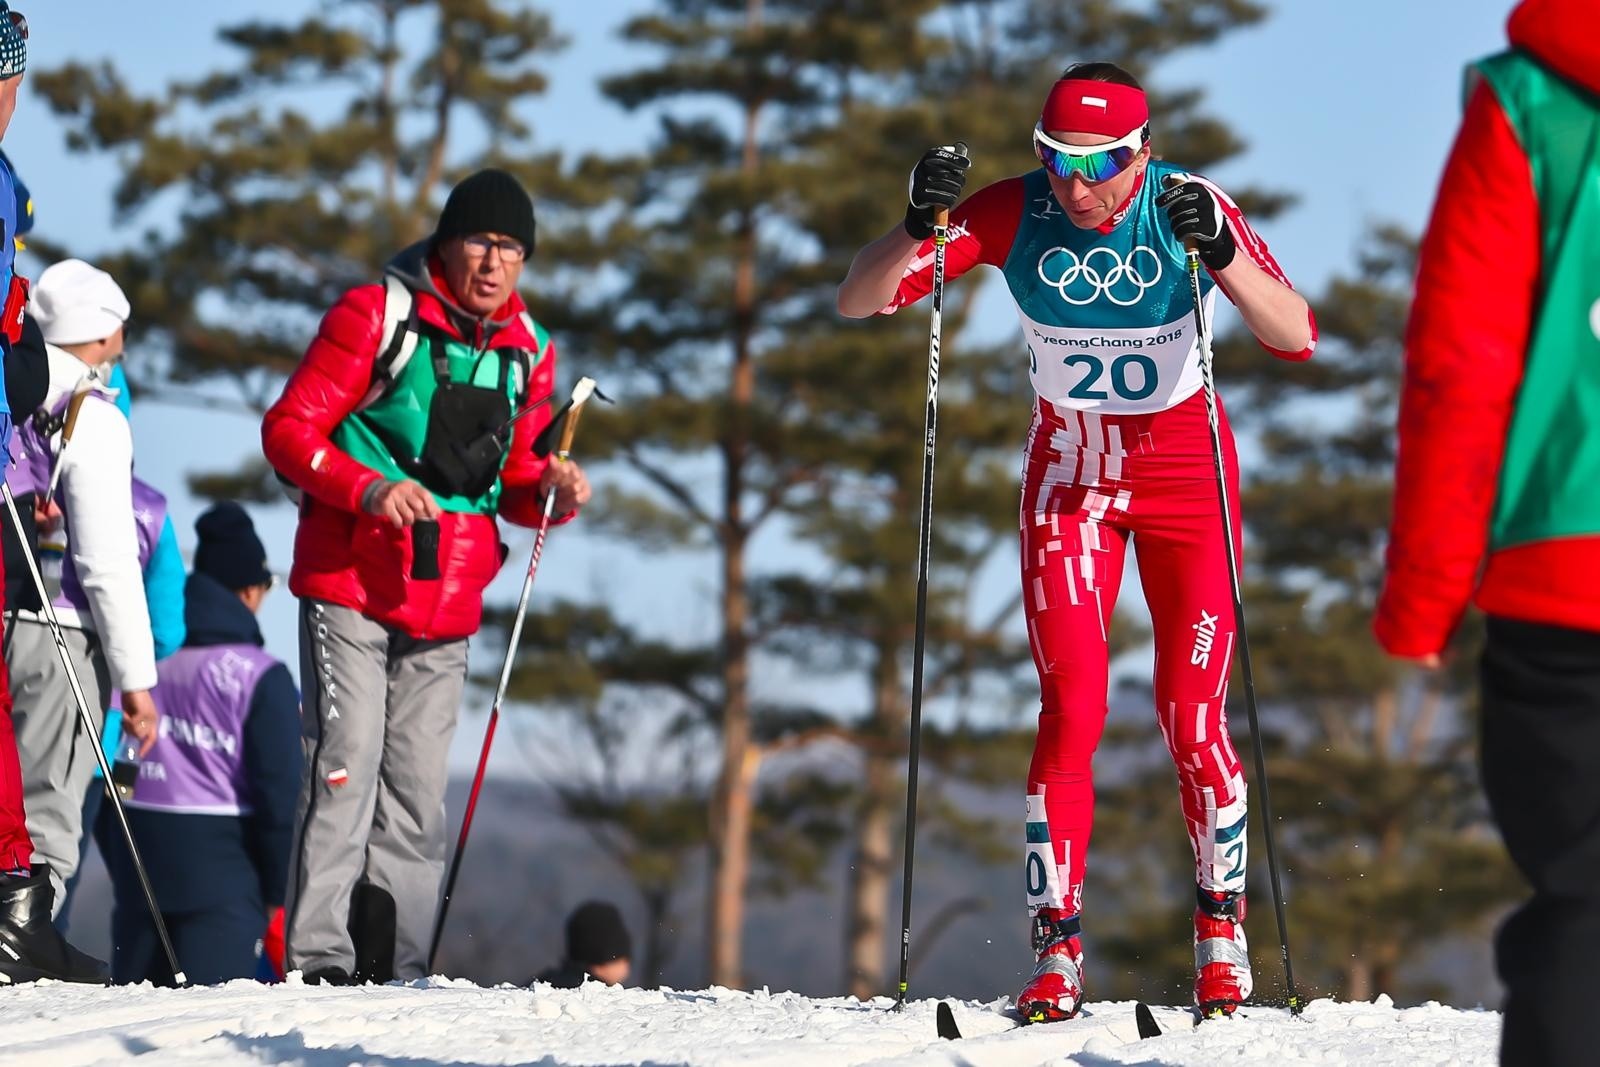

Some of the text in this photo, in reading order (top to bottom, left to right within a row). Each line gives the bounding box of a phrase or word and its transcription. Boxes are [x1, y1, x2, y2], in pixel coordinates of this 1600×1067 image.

[1033, 328, 1183, 349] PyeongChang 2018
[1062, 353, 1159, 401] 20
